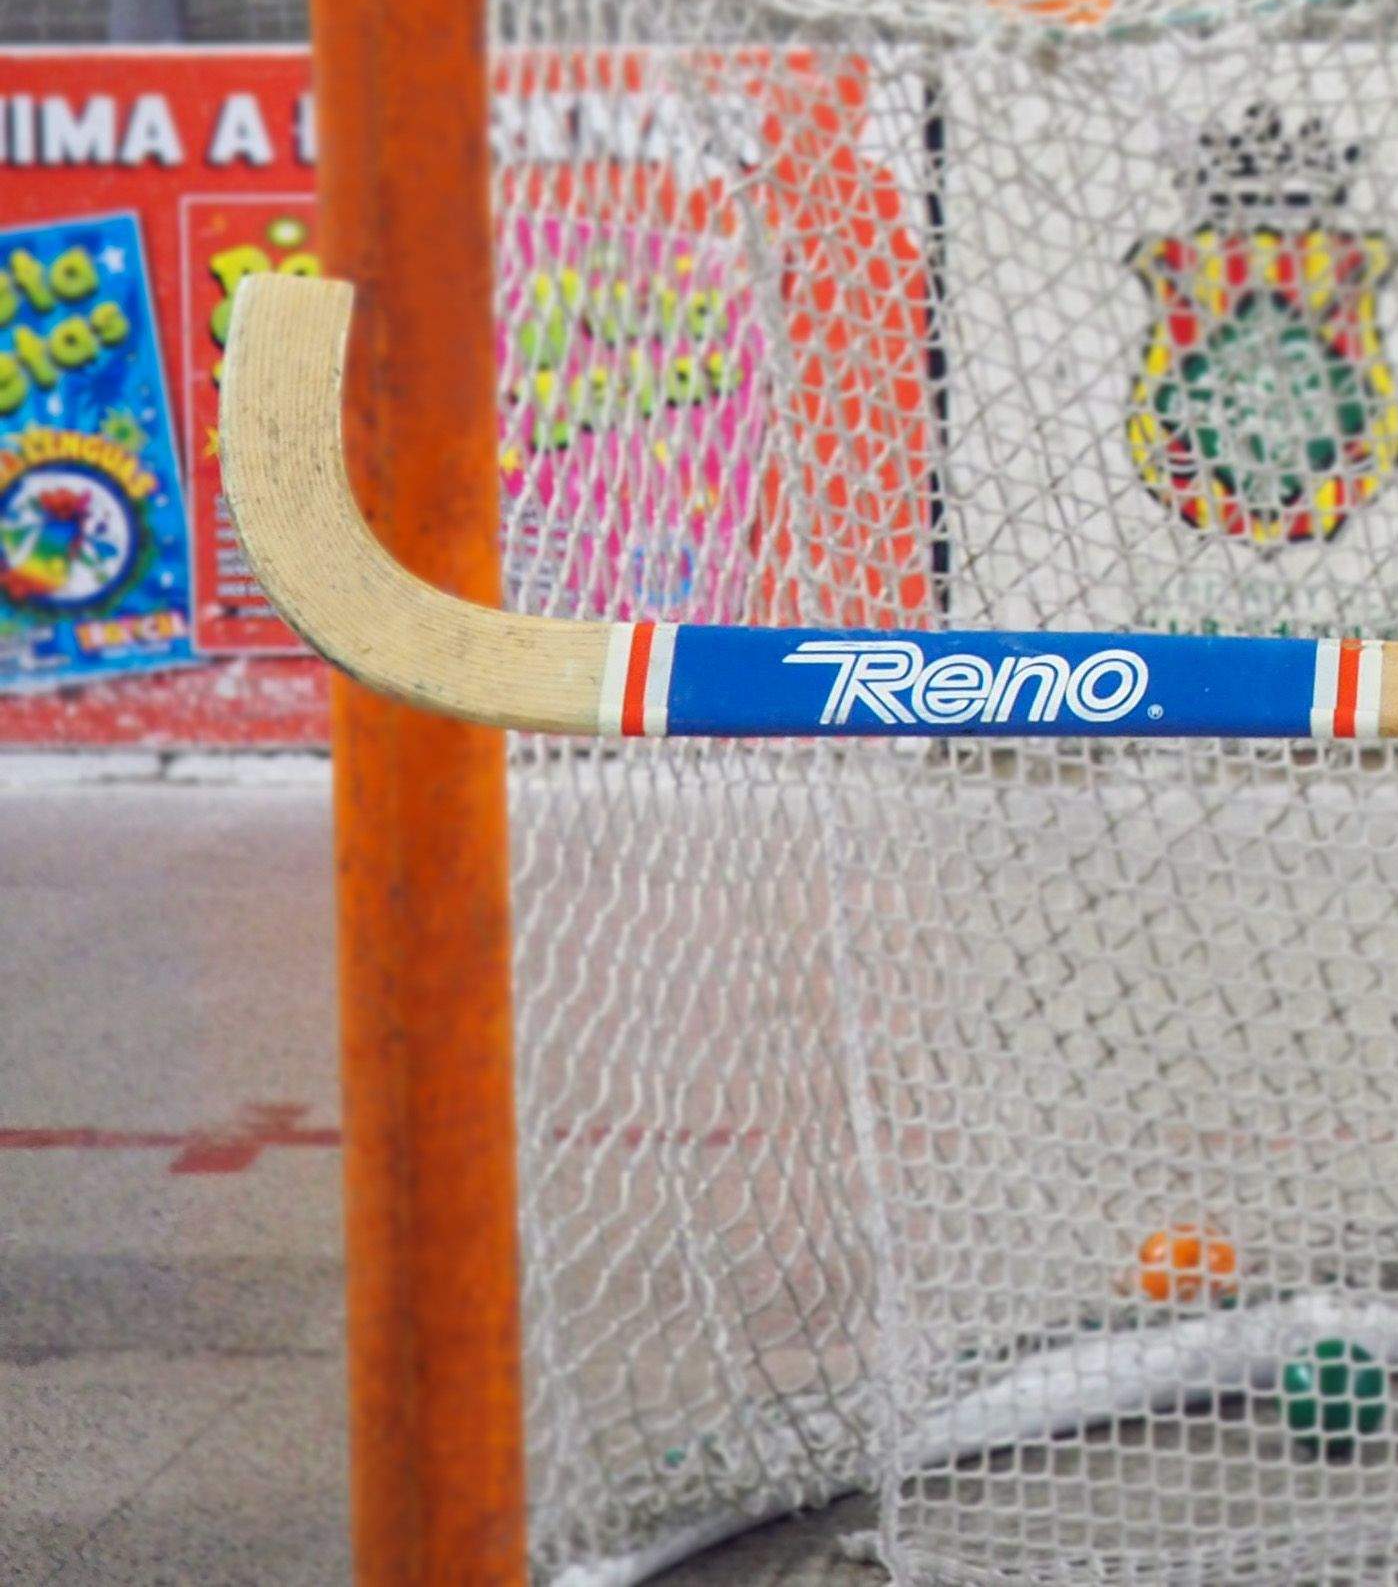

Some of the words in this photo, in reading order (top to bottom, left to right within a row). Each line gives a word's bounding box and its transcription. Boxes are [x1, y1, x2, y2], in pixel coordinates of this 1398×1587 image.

[0, 92, 185, 165] IMA
[206, 92, 274, 165] A
[781, 640, 1150, 725] Reno
